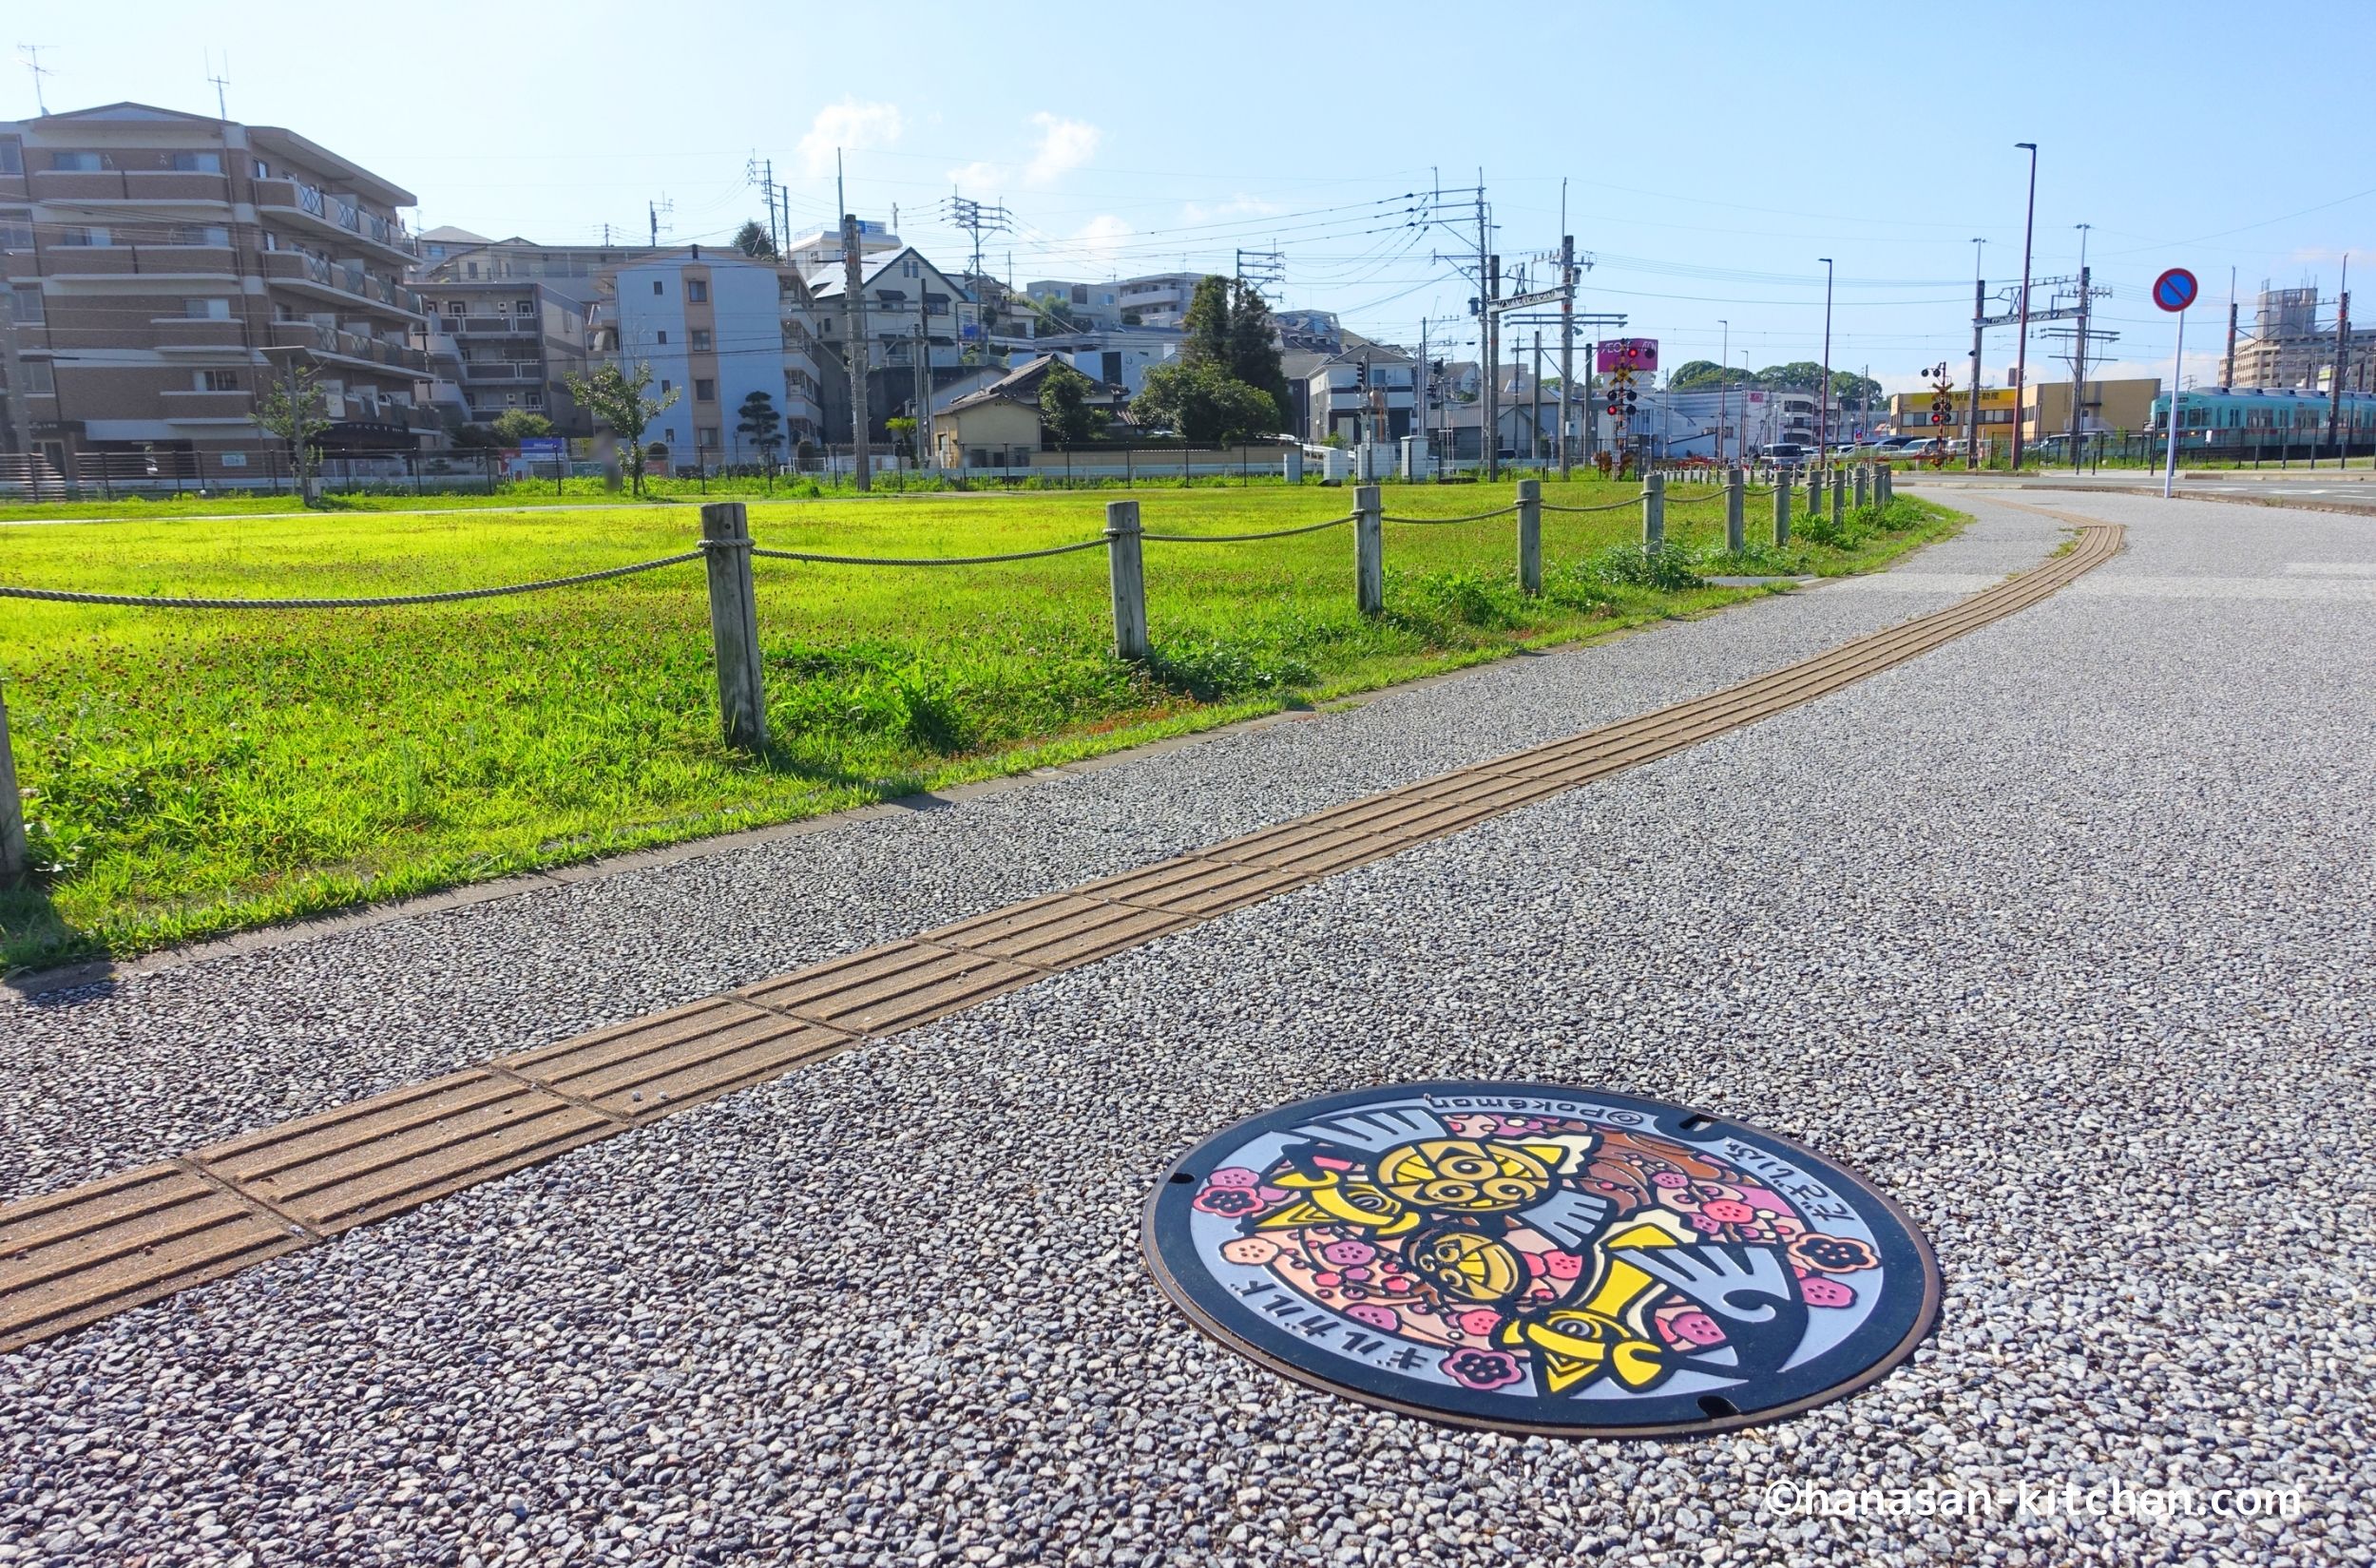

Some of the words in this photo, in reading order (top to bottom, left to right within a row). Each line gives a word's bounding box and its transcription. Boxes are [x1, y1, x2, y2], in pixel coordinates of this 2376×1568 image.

[1724, 1141, 1855, 1221] だざいふ
[1230, 1279, 1428, 1370] ギルガルド
